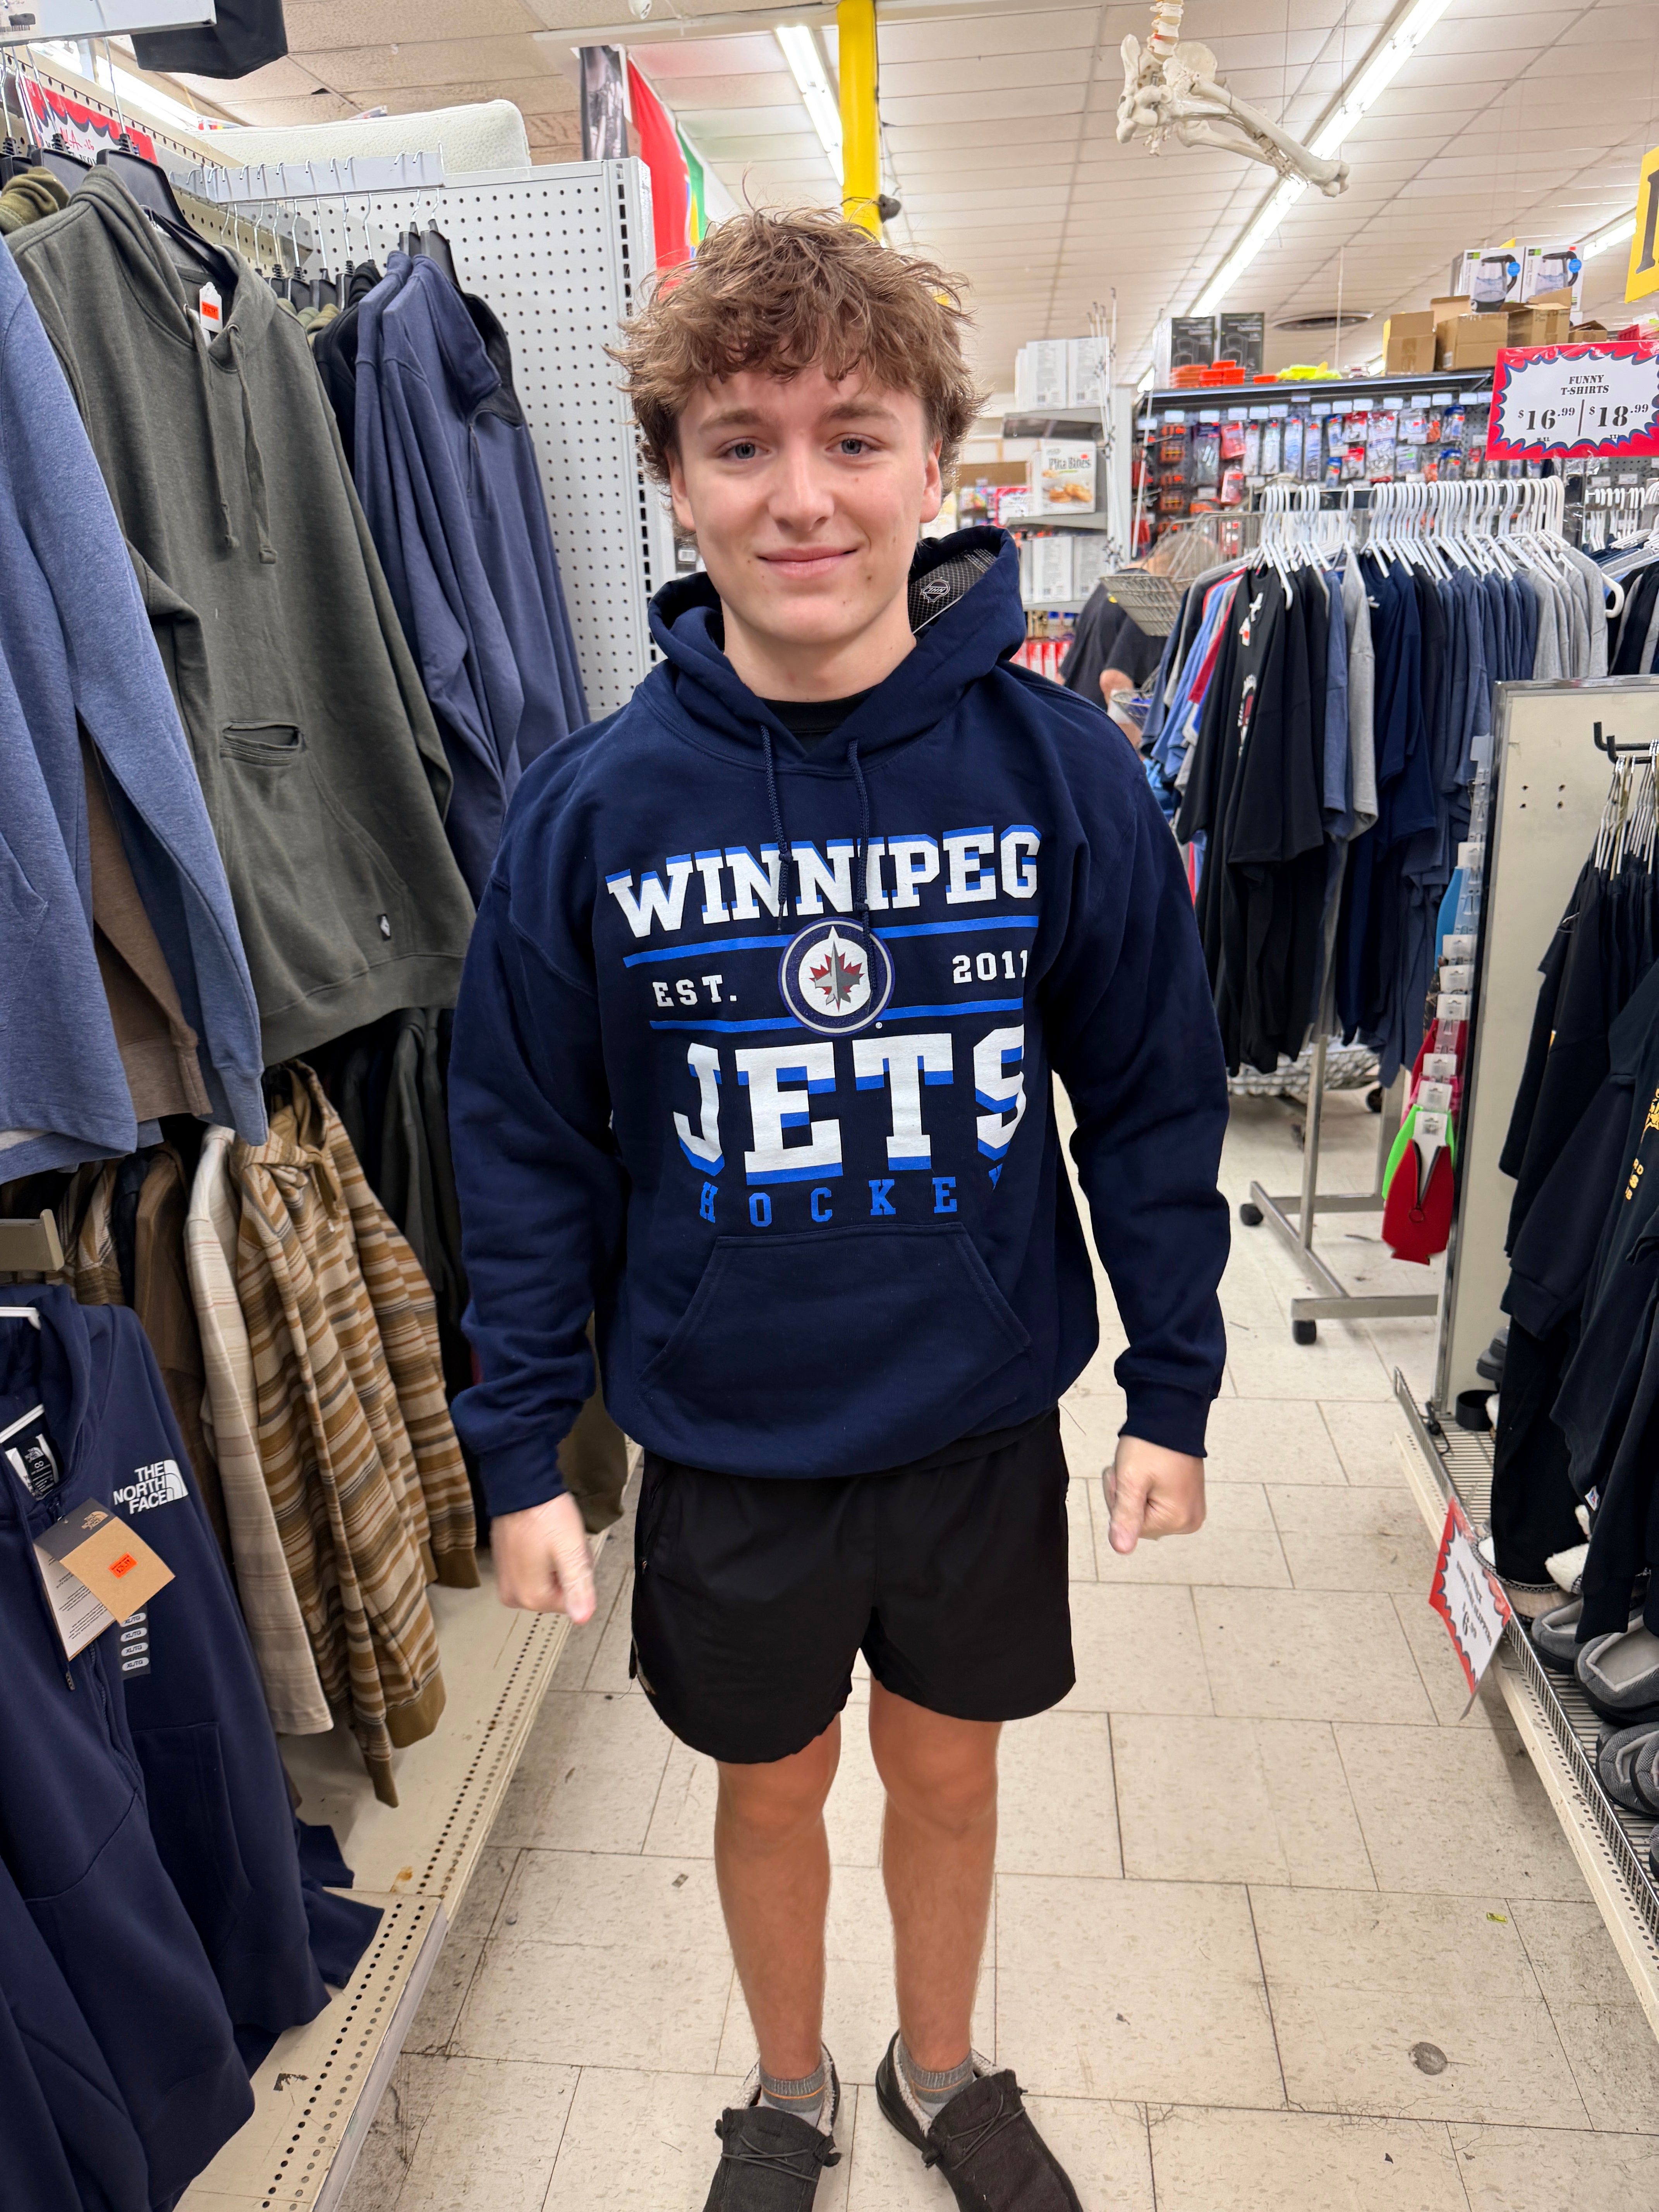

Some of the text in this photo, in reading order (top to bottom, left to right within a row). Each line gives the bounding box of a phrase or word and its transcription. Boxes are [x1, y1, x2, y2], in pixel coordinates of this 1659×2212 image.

[1561, 385, 1609, 395] T-SHIRTS
[1569, 374, 1604, 385] FUNNY
[606, 824, 1042, 938] WINNIPEG
[952, 950, 1028, 984] 2011
[652, 975, 737, 1007] EST.
[672, 1024, 1025, 1186] JETS
[134, 1461, 165, 1482] THE
[113, 1475, 166, 1505] NORTH
[129, 1489, 167, 1515] FACE
